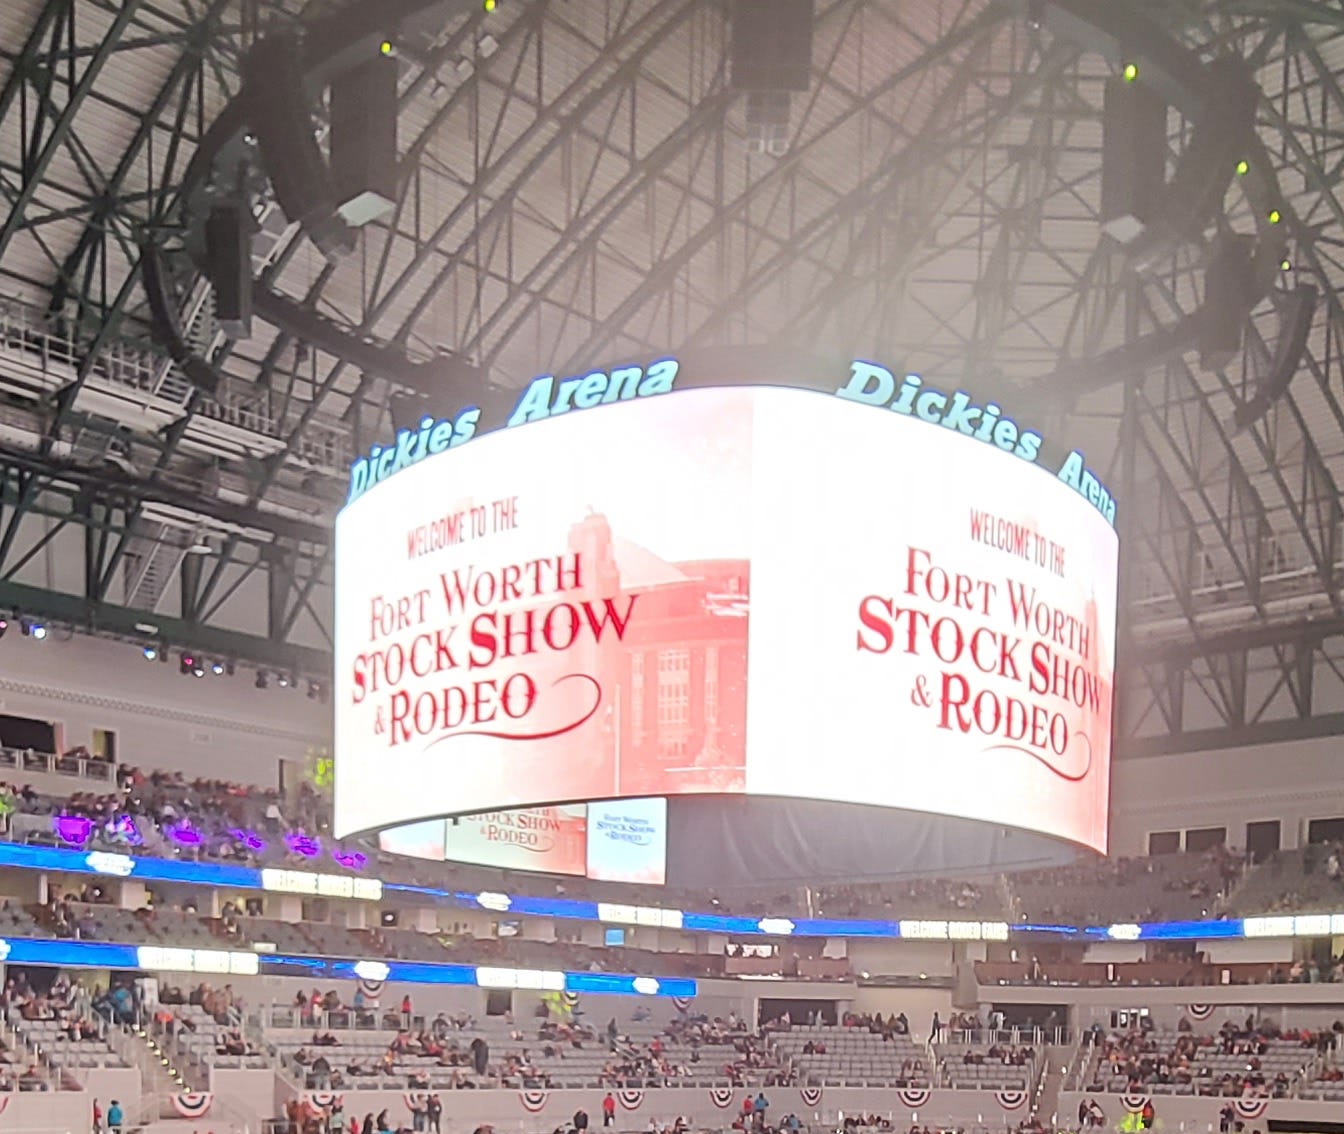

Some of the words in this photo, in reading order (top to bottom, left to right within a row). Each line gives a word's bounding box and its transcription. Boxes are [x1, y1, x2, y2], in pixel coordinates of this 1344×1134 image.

[347, 405, 481, 504] Dickies
[506, 356, 680, 428] Arena
[835, 359, 1043, 462] Dickies
[1057, 449, 1119, 527] Arena
[407, 511, 465, 560] WELCOME
[470, 505, 487, 540] TO
[492, 496, 520, 534] THE
[970, 506, 1030, 561] WELCOME
[1034, 532, 1047, 569] TO
[1049, 540, 1066, 578] THE
[369, 590, 431, 642] FORT
[440, 552, 584, 616] WORTH
[904, 545, 997, 616] FORT
[1006, 577, 1090, 660] WORTH
[352, 625, 460, 704] STOCK
[468, 594, 640, 671] SHOW
[856, 595, 1023, 682] STOCK
[1029, 641, 1103, 715] SHOW
[374, 706, 385, 735] &
[389, 672, 538, 747] RODEO
[910, 674, 934, 708] &
[937, 671, 1069, 756] RODEO
[488, 825, 538, 845] RODEO
[518, 814, 560, 831] SHOW
